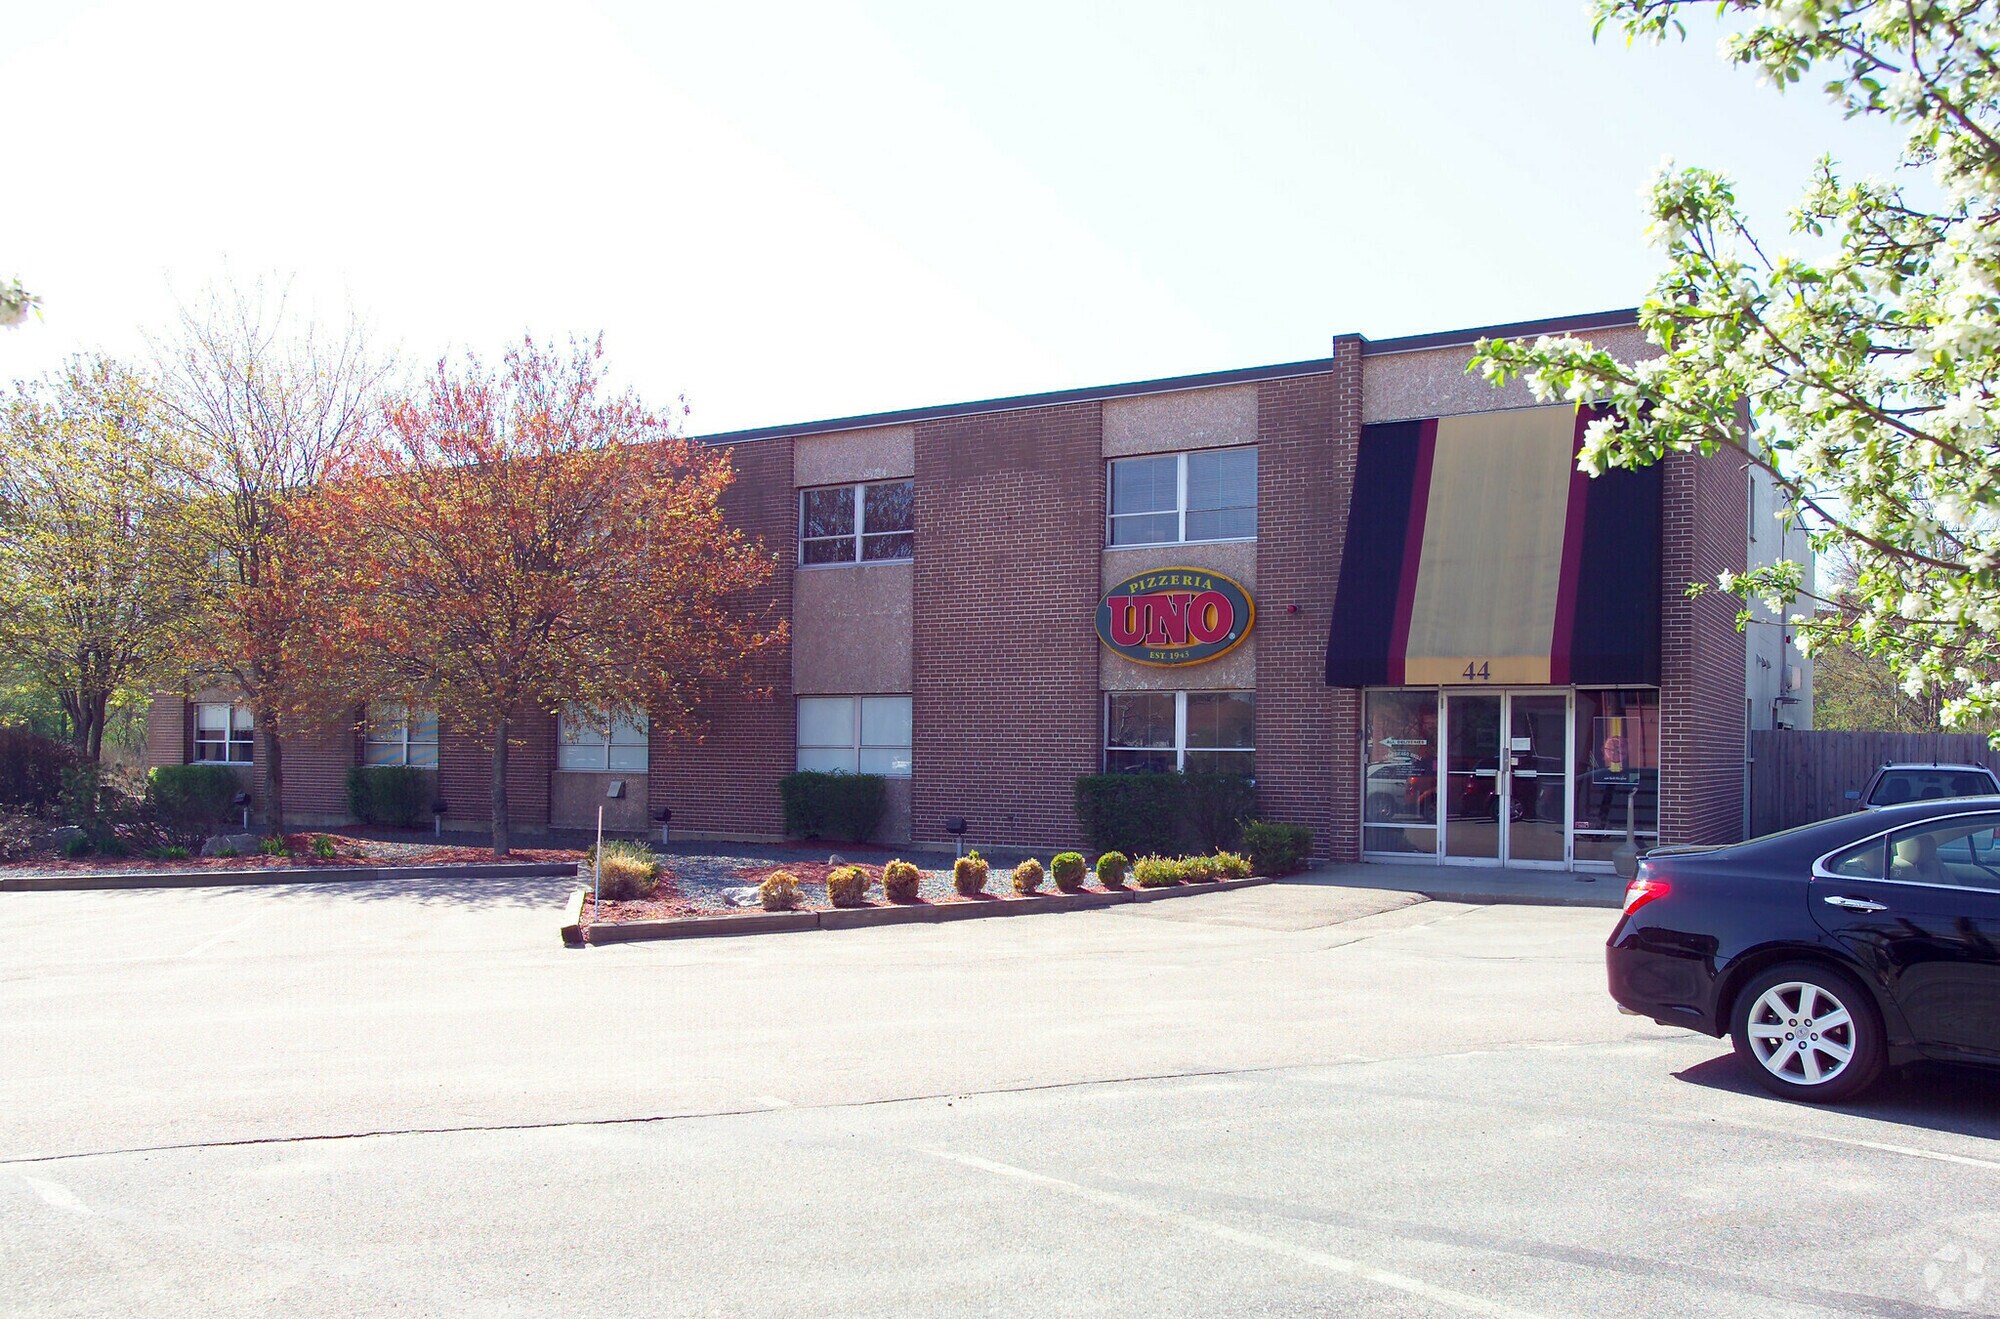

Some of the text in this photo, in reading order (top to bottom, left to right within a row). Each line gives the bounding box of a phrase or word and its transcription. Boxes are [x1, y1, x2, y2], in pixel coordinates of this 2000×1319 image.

[1129, 575, 1213, 594] PIZZERIA
[1107, 591, 1234, 646] UNO
[1169, 650, 1190, 660] 1943
[1462, 661, 1491, 680] 44
